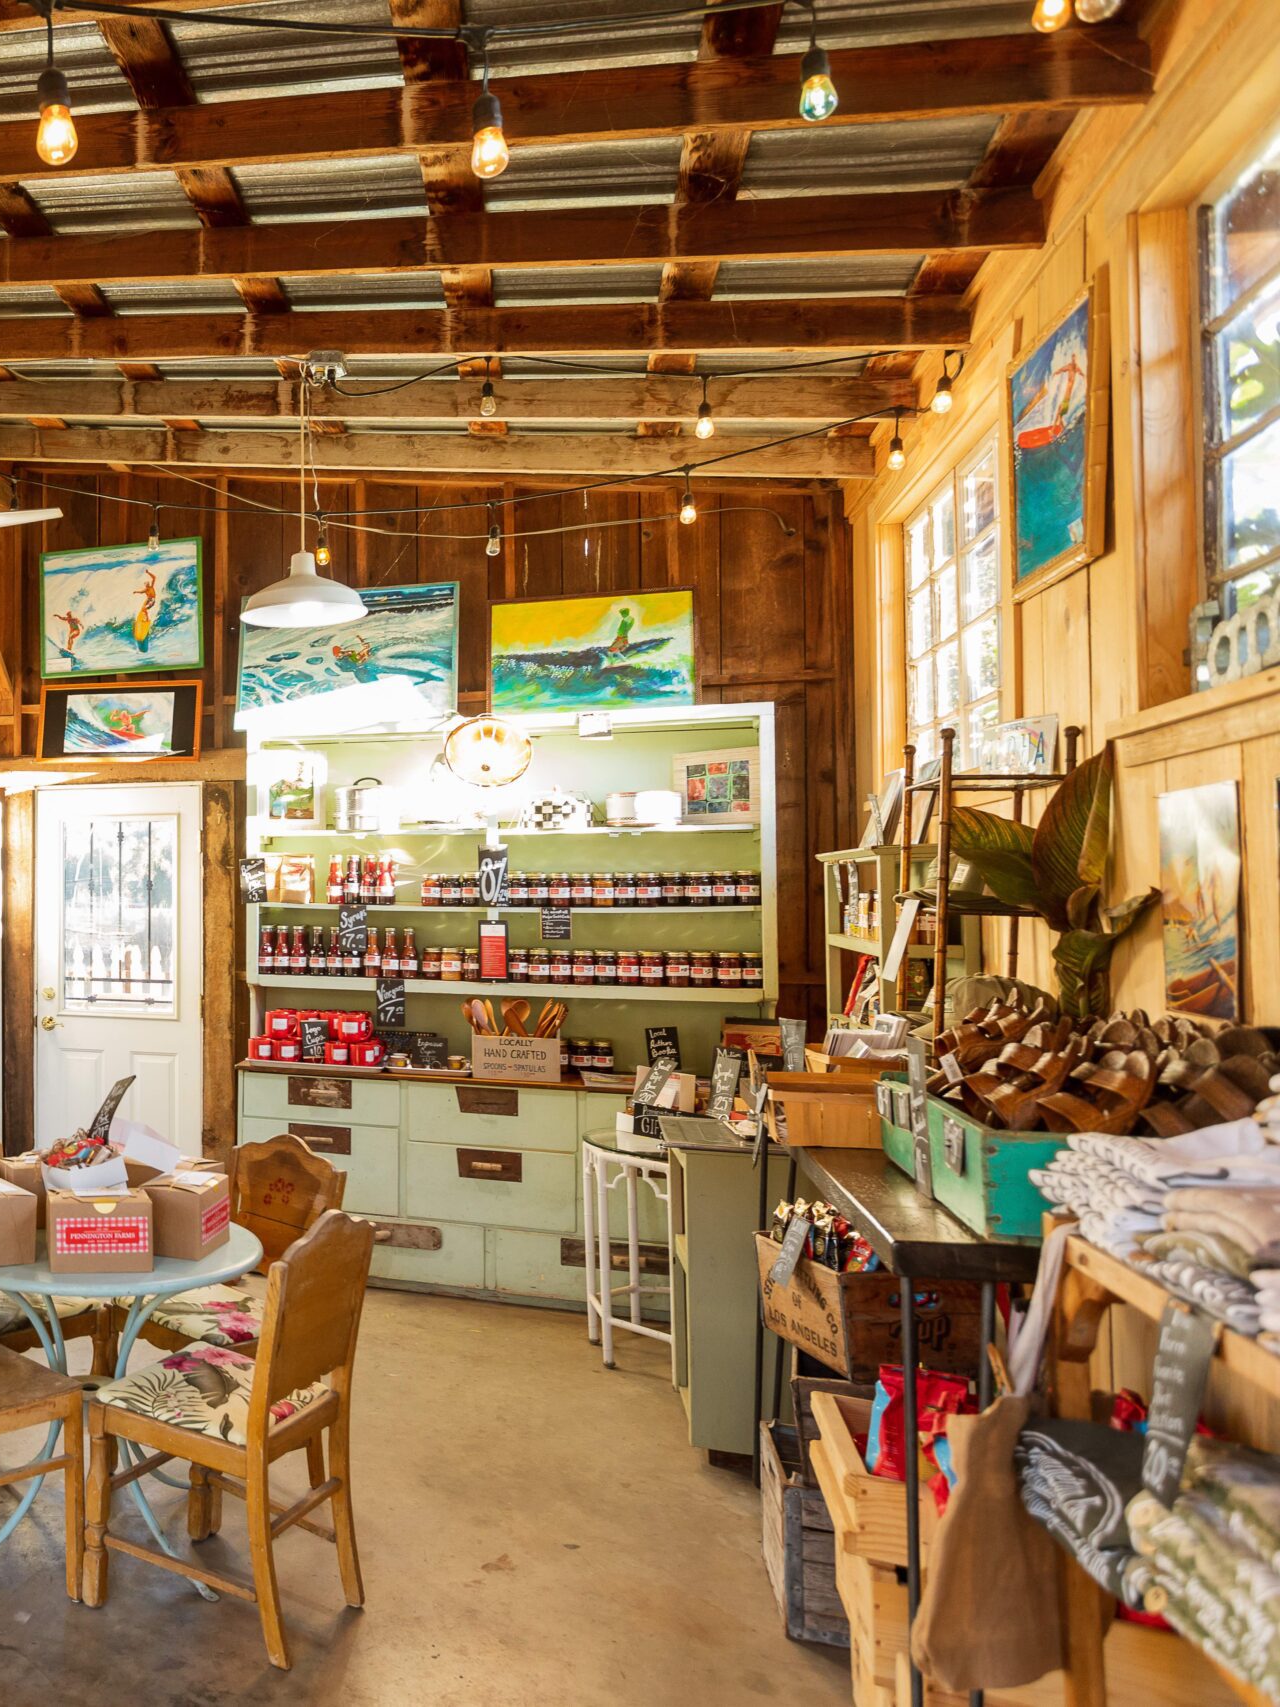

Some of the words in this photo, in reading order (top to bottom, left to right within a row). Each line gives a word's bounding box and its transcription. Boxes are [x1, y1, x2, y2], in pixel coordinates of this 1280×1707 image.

[340, 909, 368, 929] Syrups
[377, 983, 405, 1003] Vinegars
[304, 1023, 322, 1034] Logo
[648, 1028, 668, 1039] Local
[305, 1034, 326, 1046] Cups
[499, 1038, 534, 1047] LOCALLY
[484, 1048, 507, 1058] HAND
[510, 1049, 547, 1060] CRAFTED
[651, 1047, 678, 1058] Books
[483, 1062, 507, 1071] SPOONS
[513, 1063, 546, 1073] SPATULAS
[641, 1116, 663, 1136] GIF
[70, 1232, 113, 1240] PENNINGTON
[114, 1231, 136, 1239] FARMS
[770, 1311, 787, 1328] LOS
[791, 1318, 838, 1358] ANGELES
